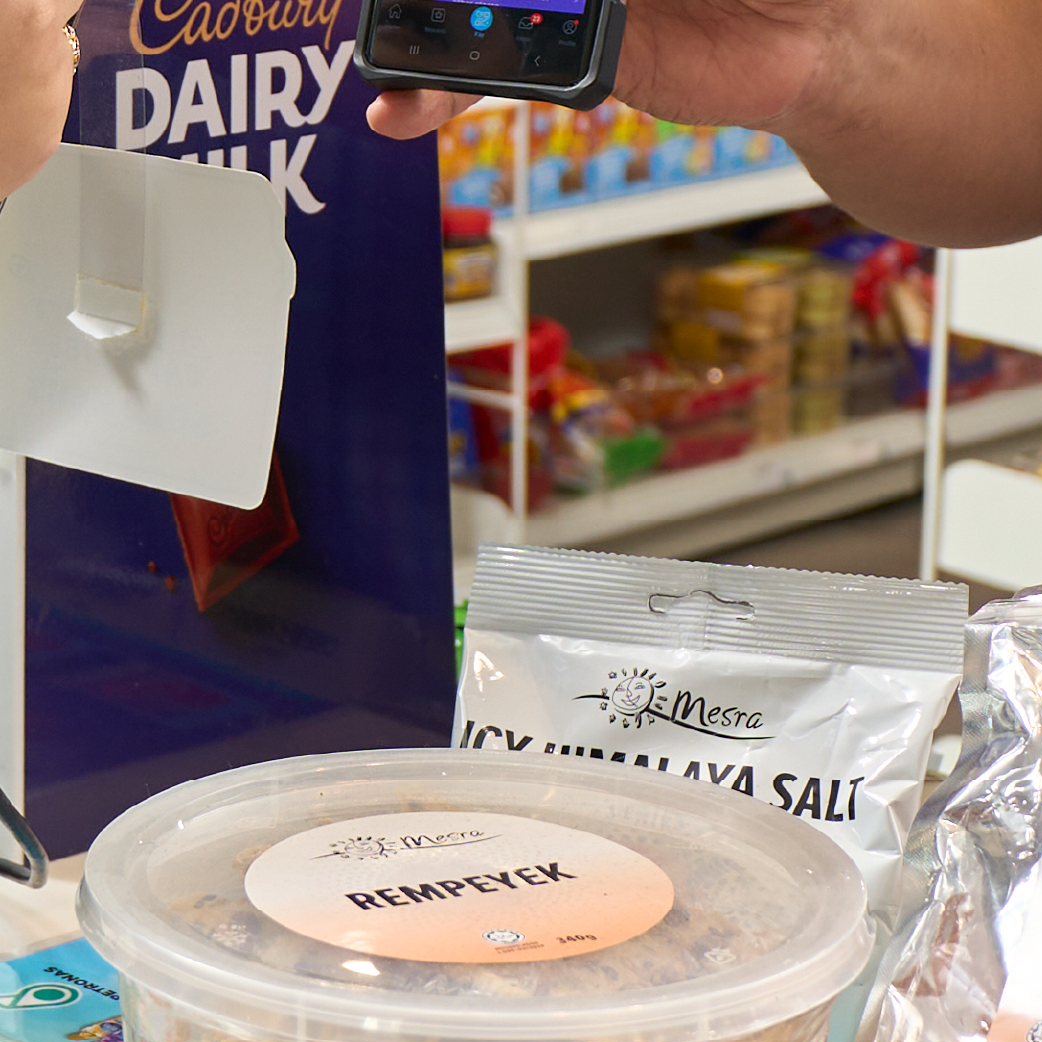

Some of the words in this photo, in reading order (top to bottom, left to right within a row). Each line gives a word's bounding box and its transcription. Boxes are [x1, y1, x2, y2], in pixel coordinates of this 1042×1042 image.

[129, 0, 342, 55] Cadbury
[116, 40, 356, 150] DAIRY
[669, 690, 764, 729] Mesra
[769, 772, 865, 822] SALT
[400, 827, 485, 850] Mesra
[345, 862, 579, 911] REMPEYEK
[44, 965, 120, 1002] PETRONAS
